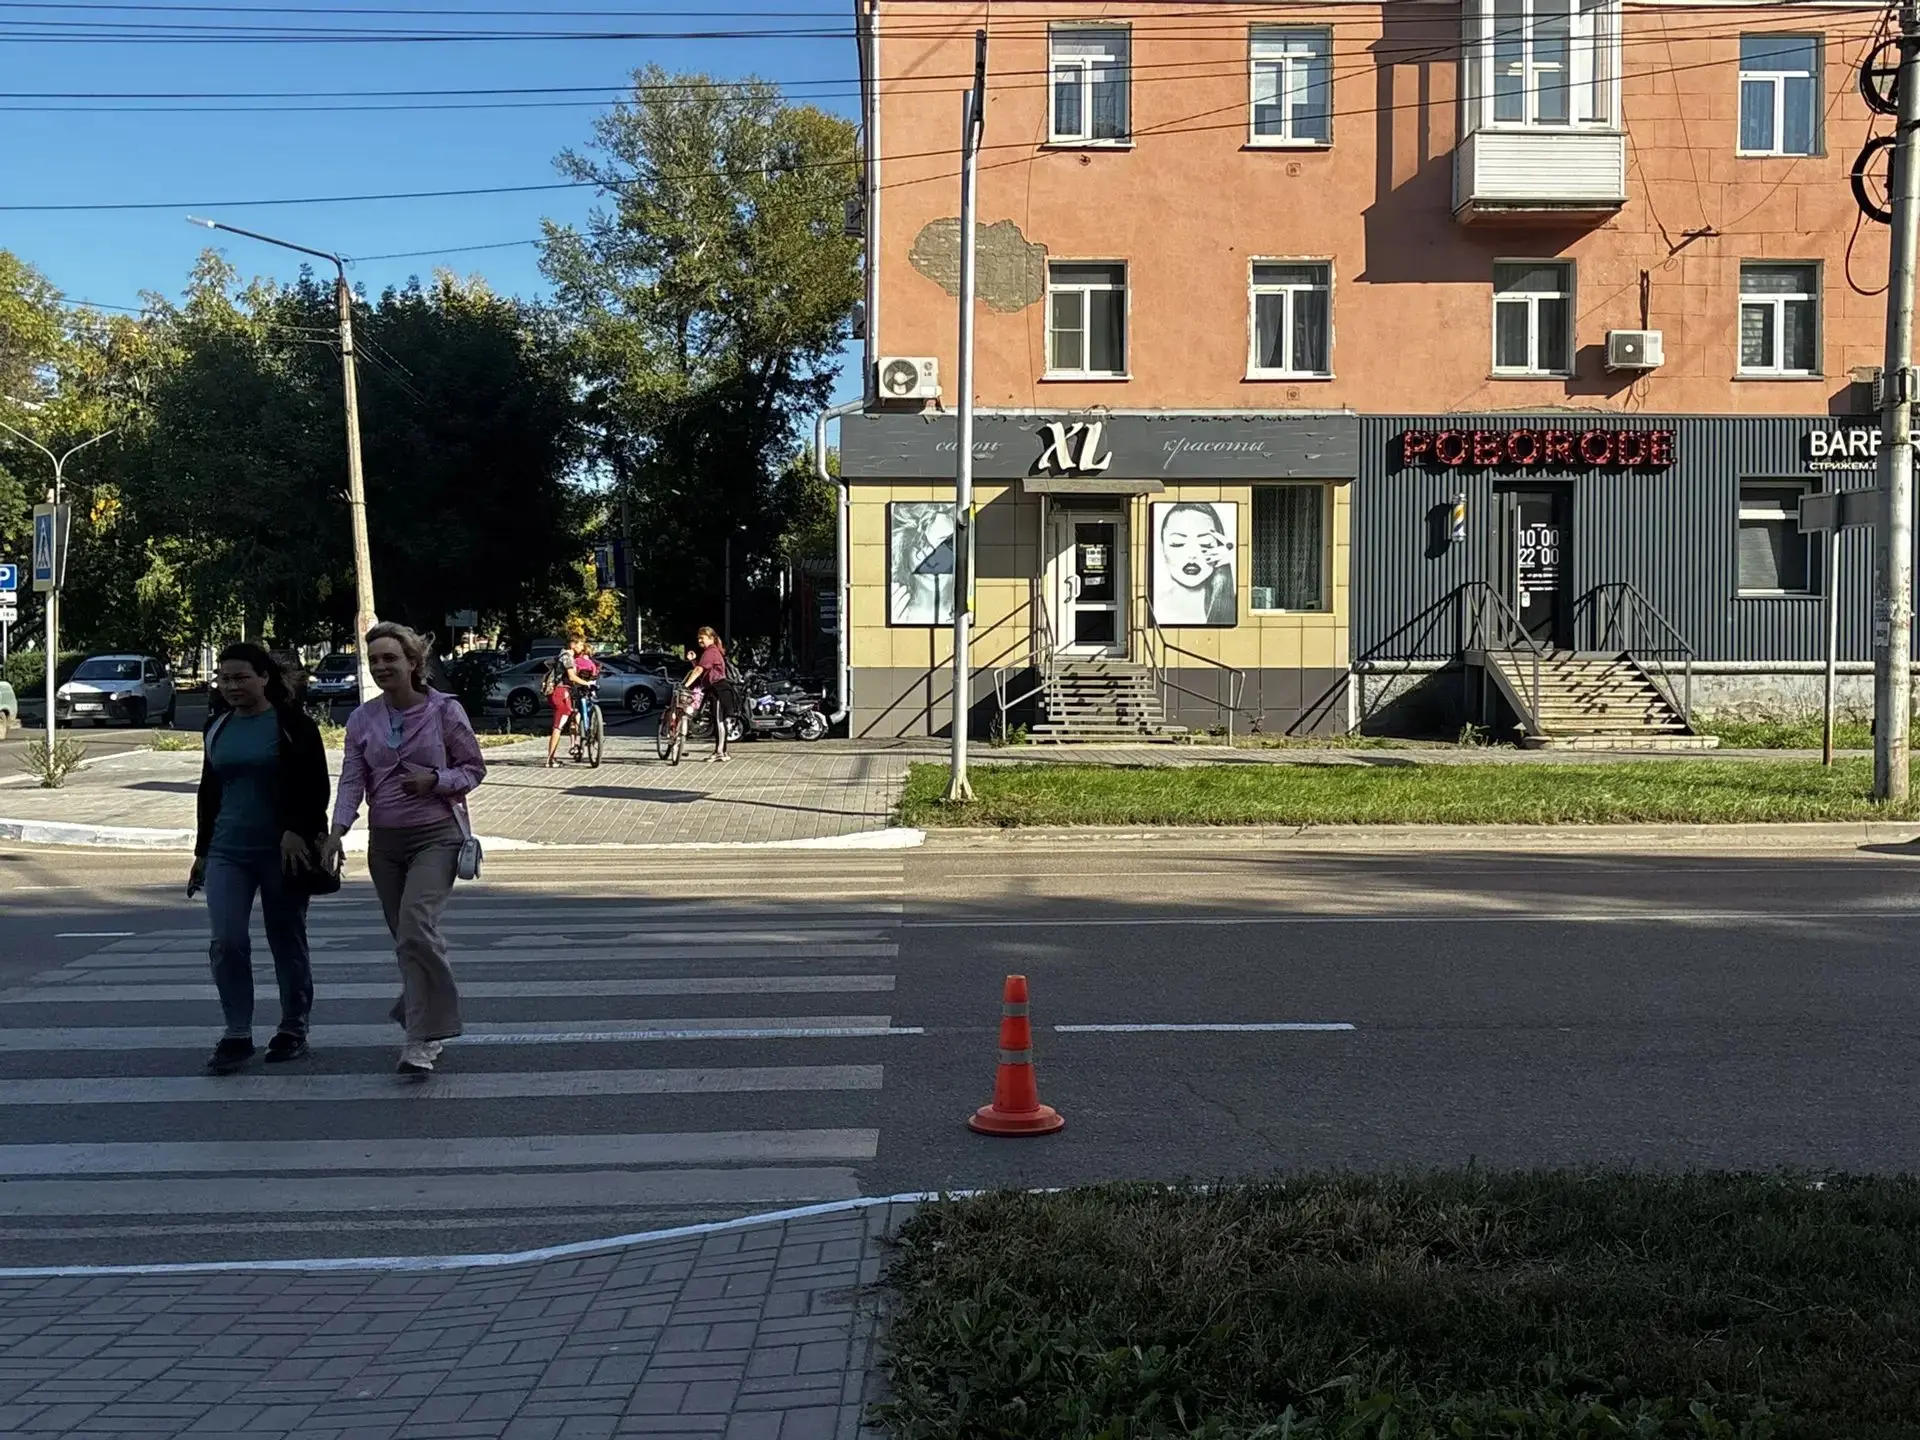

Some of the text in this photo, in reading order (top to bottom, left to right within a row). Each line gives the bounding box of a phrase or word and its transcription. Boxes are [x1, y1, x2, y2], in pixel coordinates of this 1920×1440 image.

[935, 437, 1265, 470] саон красоты
[1038, 421, 1113, 471] XL
[1403, 428, 1678, 466] POBORODE
